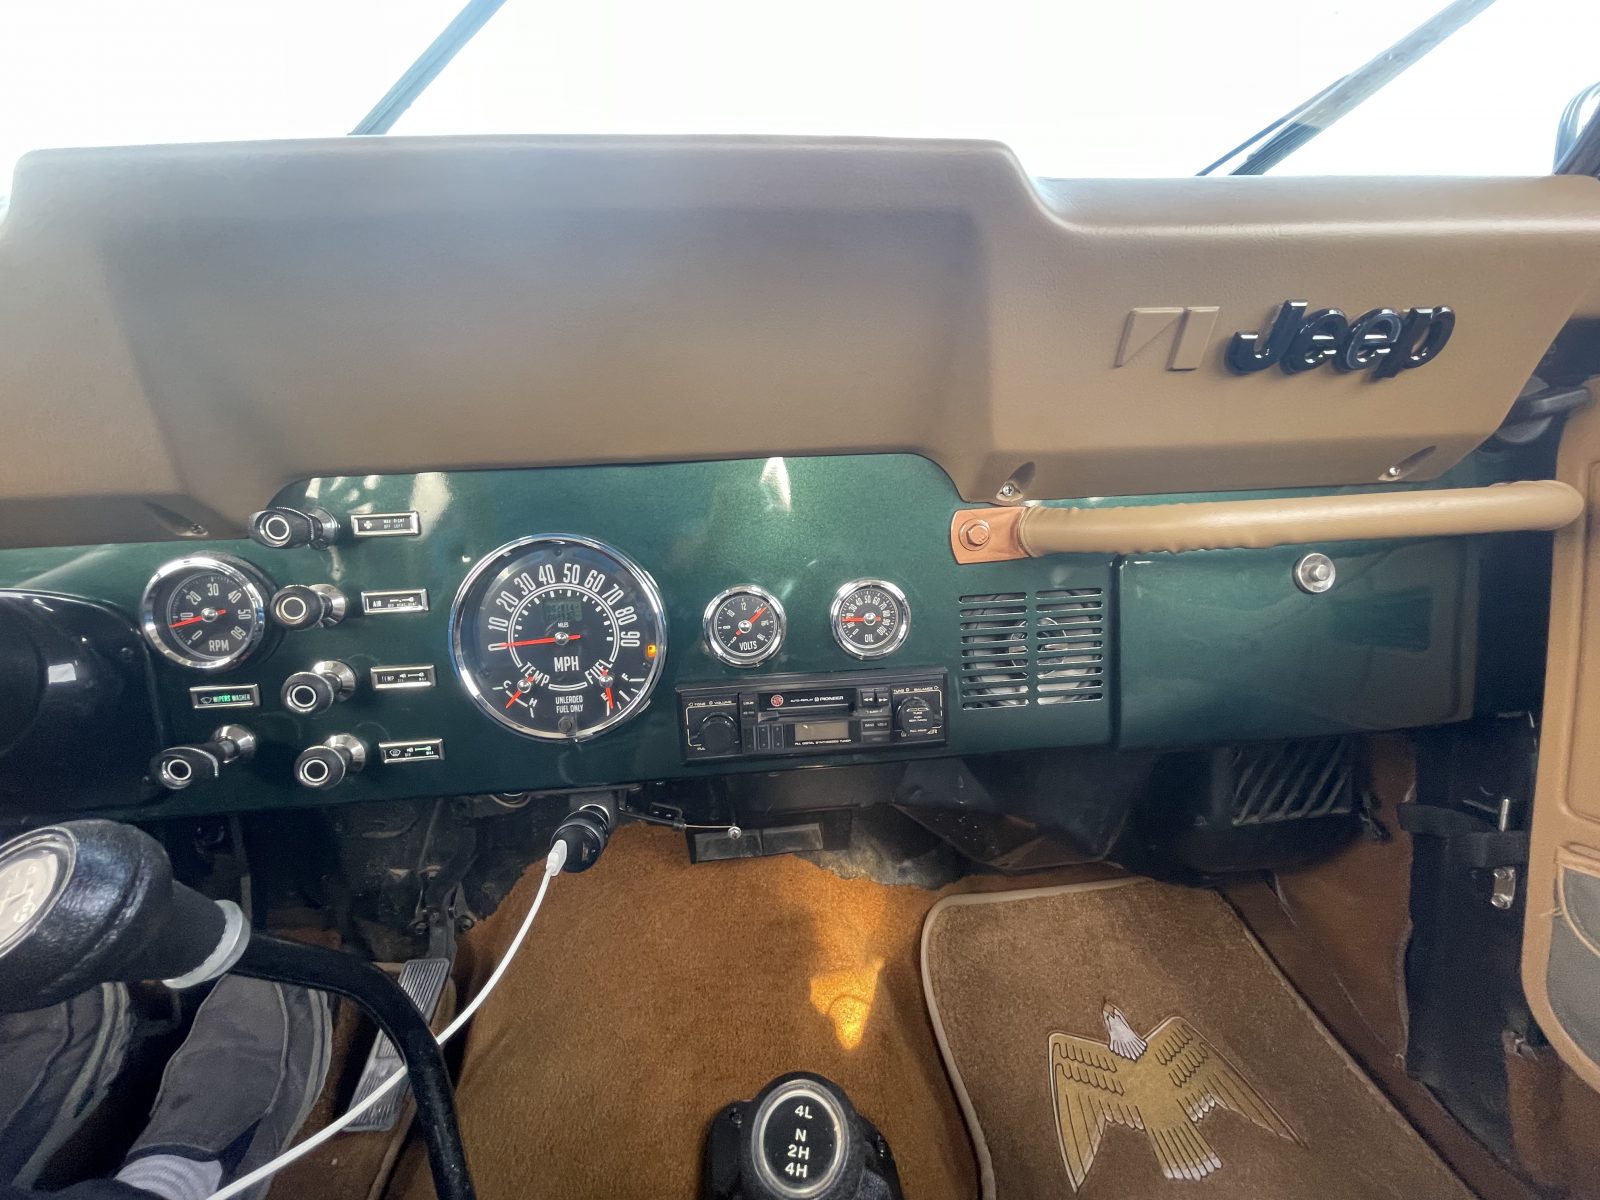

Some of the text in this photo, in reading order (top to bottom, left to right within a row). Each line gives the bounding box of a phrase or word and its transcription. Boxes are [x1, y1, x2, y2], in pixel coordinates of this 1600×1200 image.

[1223, 299, 1456, 378] Jeep
[538, 563, 556, 585] 40
[563, 563, 580, 584] 50
[513, 572, 537, 595] 30
[584, 569, 606, 592] 60
[207, 583, 219, 596] 30
[227, 589, 242, 603] 40
[601, 583, 624, 606] 70
[186, 590, 201, 605] 20
[372, 600, 382, 608] AIR
[495, 590, 519, 613] 20
[855, 597, 864, 606] 40
[864, 595, 871, 604] 50
[872, 596, 880, 606] 60
[740, 602, 747, 611] 12
[848, 603, 858, 612] 30
[878, 601, 888, 610] 70
[237, 609, 252, 620] 50
[614, 605, 638, 626] 80
[487, 616, 509, 632] 10
[192, 630, 203, 641] 0
[230, 626, 246, 640] 60
[852, 628, 860, 636] 0
[864, 633, 874, 643] OIL
[208, 639, 230, 652] RPM
[620, 630, 641, 648] 90
[739, 640, 758, 651] VOLTS
[487, 642, 508, 652] 0
[553, 655, 580, 672] MPH
[520, 661, 550, 686] TEMP
[584, 659, 613, 684] FUEL
[621, 672, 629, 680] F
[503, 680, 512, 688] C
[212, 693, 251, 702] WIPERS WASHER
[528, 697, 538, 707] H
[555, 694, 584, 704] UNLEADED
[600, 692, 609, 701] E
[556, 703, 584, 714] FUEL ONLY
[794, 1104, 812, 1119] 4L
[795, 1128, 807, 1142] N
[787, 1144, 810, 1160] 2H
[784, 1162, 808, 1178] 4H
